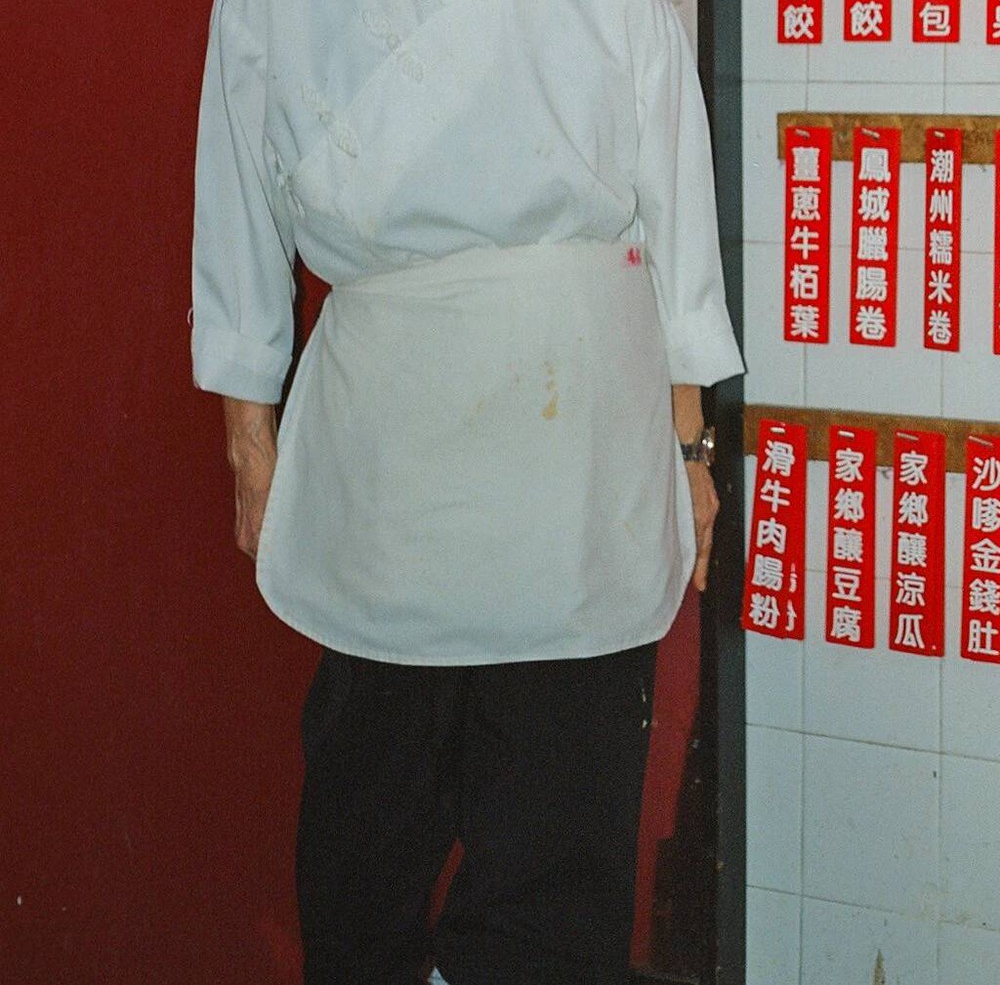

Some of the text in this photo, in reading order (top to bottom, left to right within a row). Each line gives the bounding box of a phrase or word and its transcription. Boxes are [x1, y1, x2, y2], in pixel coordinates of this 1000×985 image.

[928, 149, 953, 344] 潮州糯米卷
[748, 440, 796, 629] 滑牛肉腸粉
